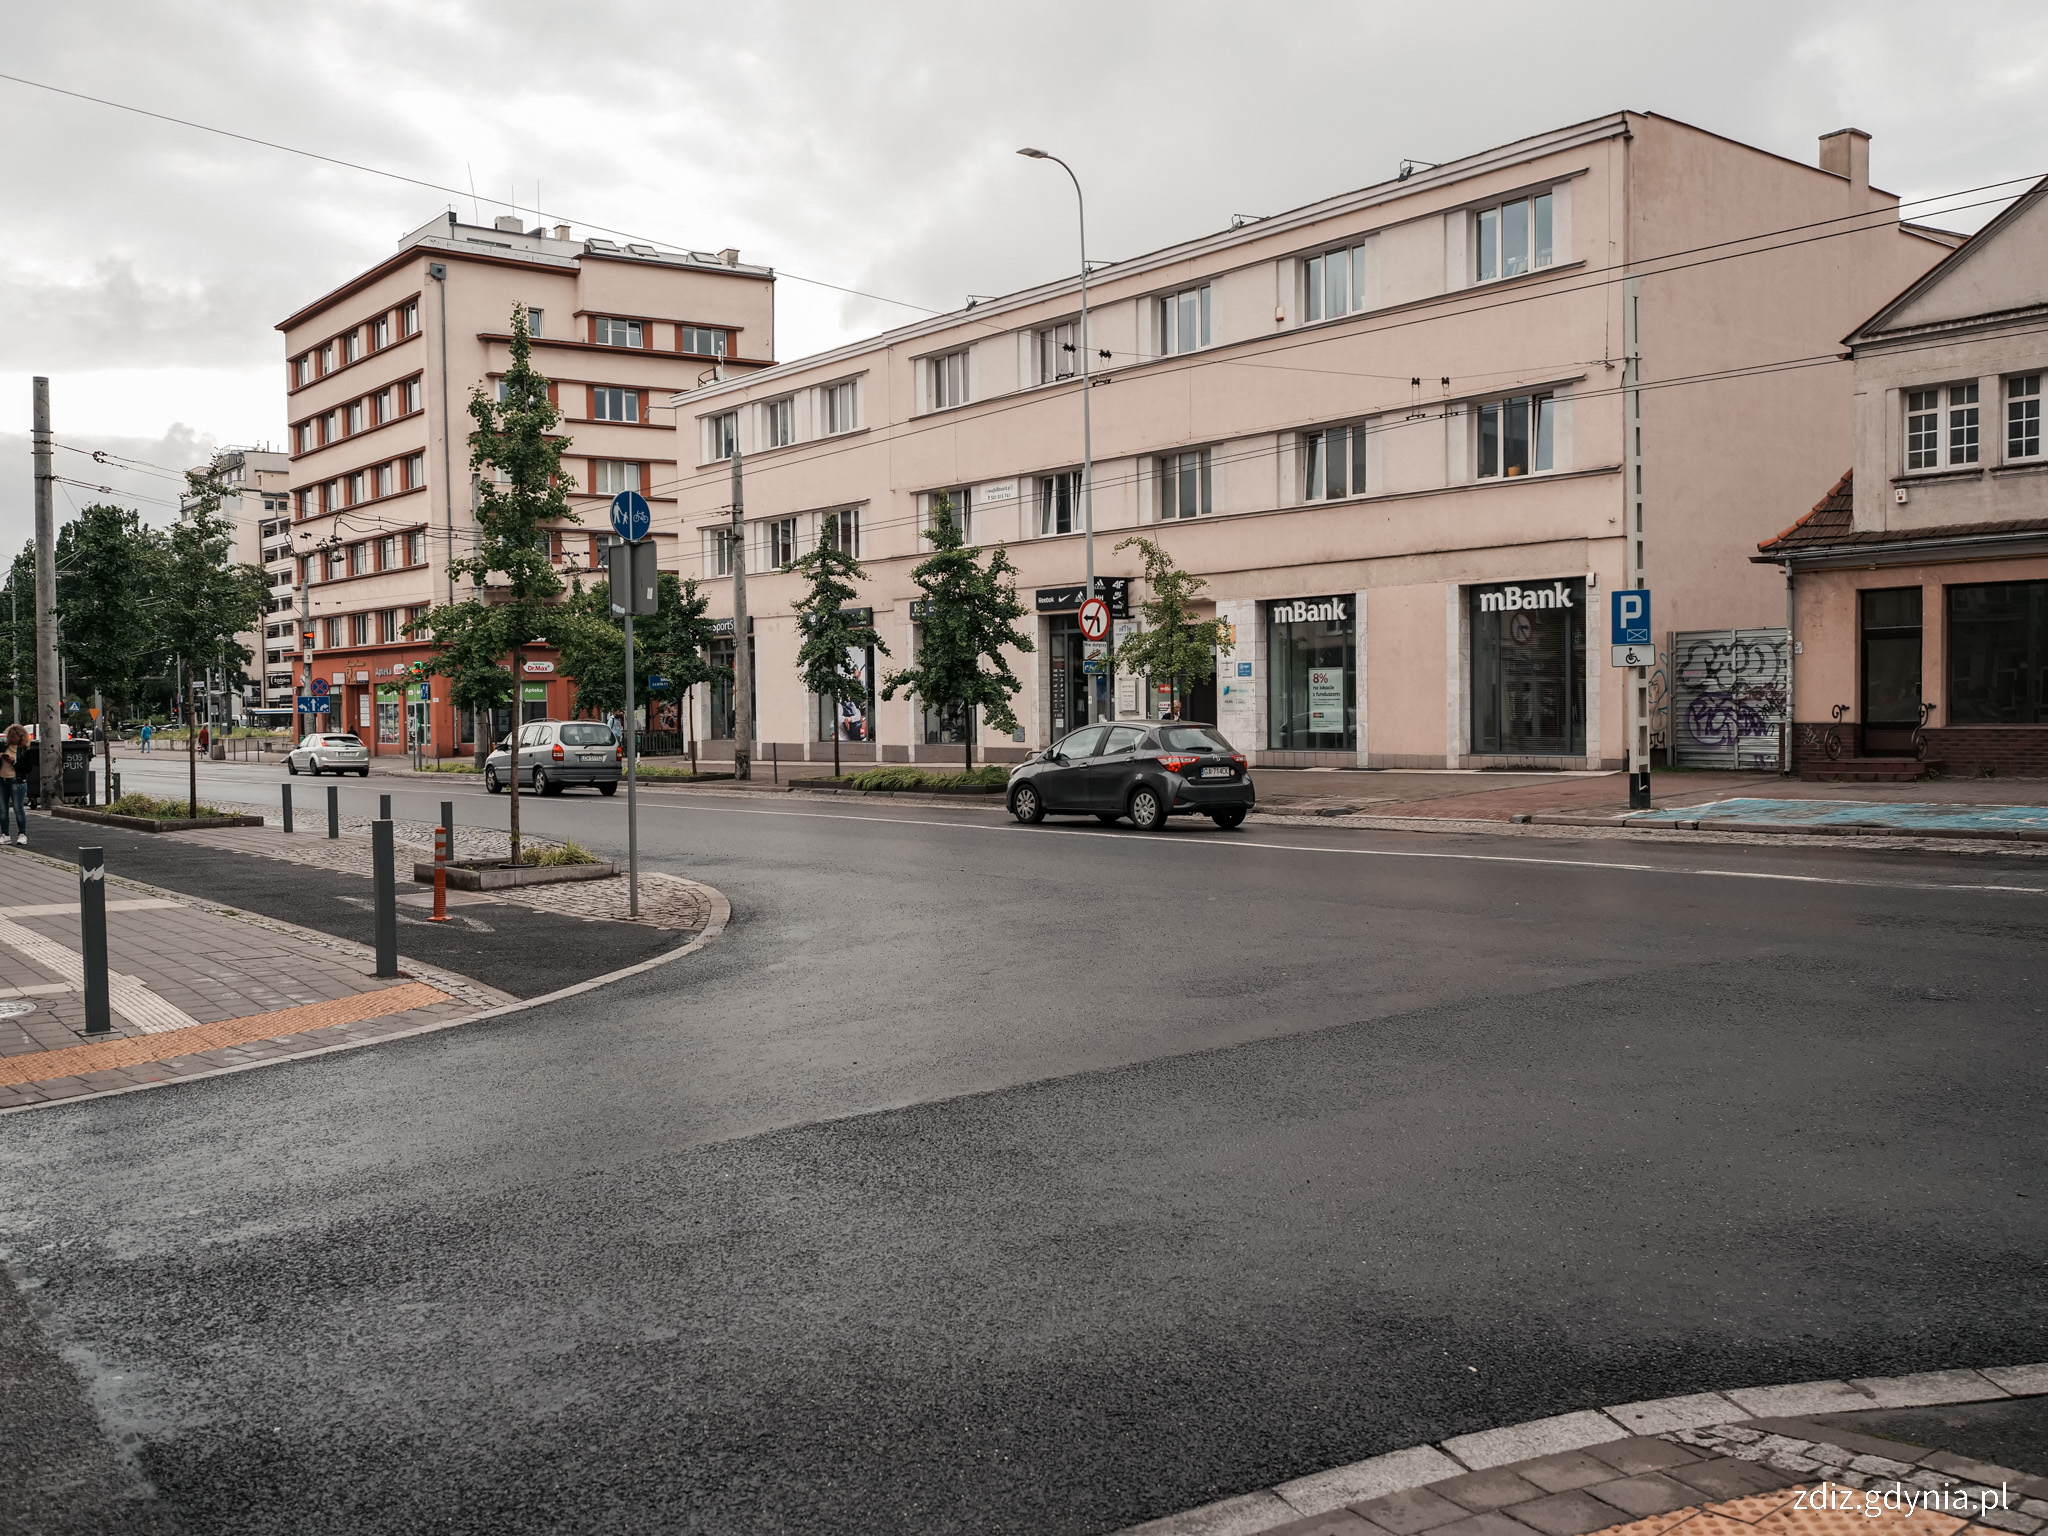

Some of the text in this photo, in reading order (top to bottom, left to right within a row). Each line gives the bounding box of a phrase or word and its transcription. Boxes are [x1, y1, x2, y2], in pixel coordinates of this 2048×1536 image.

[1112, 580, 1125, 589] 4F
[1480, 582, 1574, 612] mBank
[1274, 597, 1347, 623] mBank
[1620, 595, 1642, 629] P
[1313, 673, 1328, 683] 8%
[63, 761, 84, 770] PUK
